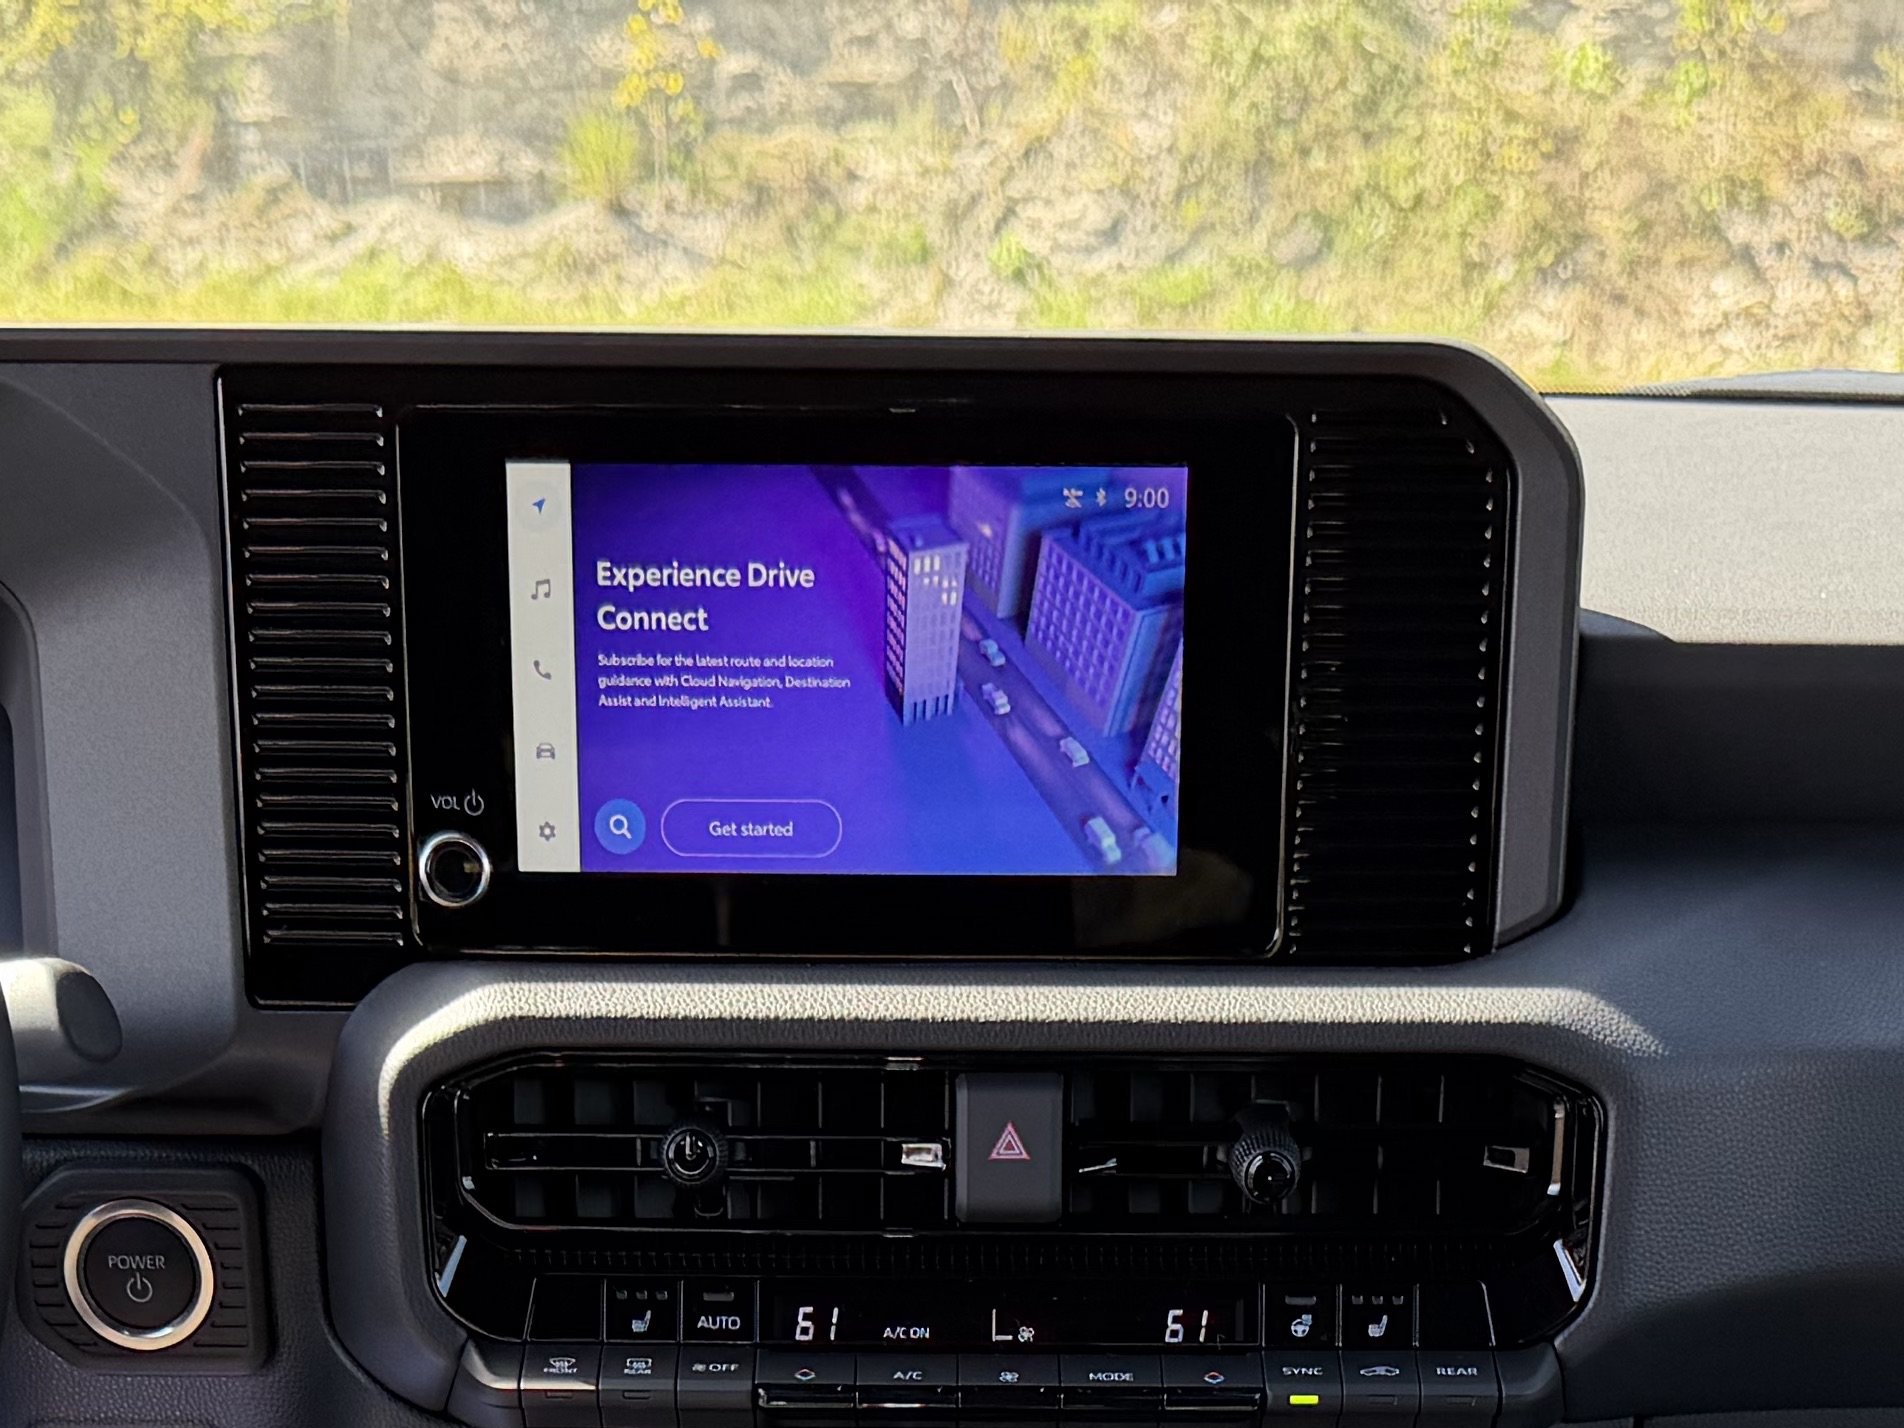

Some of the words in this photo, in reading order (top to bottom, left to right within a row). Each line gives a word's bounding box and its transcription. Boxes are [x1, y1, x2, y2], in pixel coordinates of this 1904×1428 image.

[1124, 486, 1171, 510] 9:00
[597, 560, 742, 593] Experience
[747, 560, 815, 588] Drive
[597, 604, 709, 631] Connect
[597, 654, 655, 667] Subscribe
[656, 654, 673, 667] for
[674, 654, 695, 667] the
[696, 654, 729, 667] latest
[730, 656, 762, 668] route
[763, 655, 786, 668] and
[787, 655, 834, 668] location
[598, 675, 652, 689] guidance
[654, 675, 678, 687] with
[680, 675, 716, 688] Cloud
[718, 675, 784, 690] Navigation,
[785, 676, 852, 688] Destination
[598, 694, 633, 707] Assist
[634, 694, 656, 707] and
[658, 695, 717, 710] Intelligent
[430, 795, 461, 811] VOL
[708, 819, 741, 839] Get
[743, 820, 794, 839] started
[108, 1254, 166, 1270] POWER
[697, 1315, 741, 1331] AUTO
[795, 1306, 839, 1341] 61
[1165, 1309, 1209, 1343] 61
[883, 1326, 907, 1340] A/C
[909, 1326, 931, 1340] ON
[708, 1362, 740, 1373] OFF
[1282, 1366, 1324, 1377] SYNC
[1436, 1367, 1478, 1377] REAR
[893, 1371, 923, 1381] A/C
[1089, 1372, 1134, 1382] MODE
